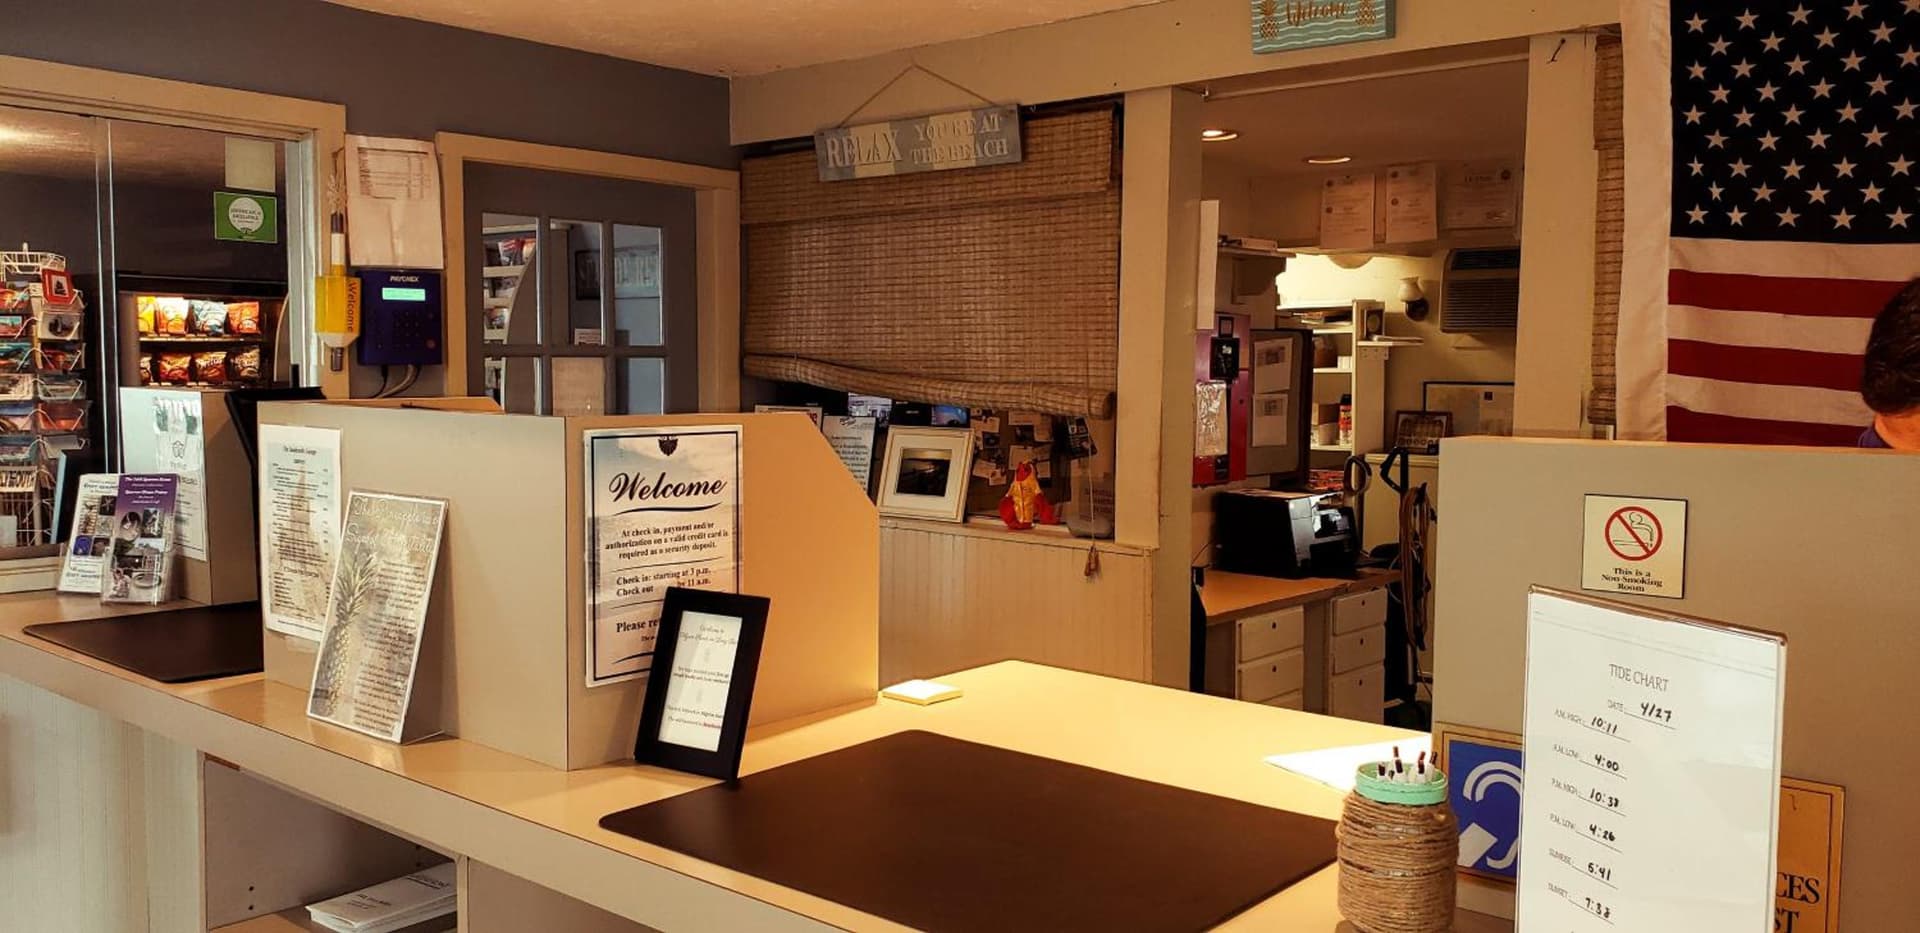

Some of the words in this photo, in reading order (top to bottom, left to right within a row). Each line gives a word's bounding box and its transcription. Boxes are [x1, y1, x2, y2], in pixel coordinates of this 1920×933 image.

[980, 112, 1002, 133] AT
[826, 131, 903, 168] RELAX
[910, 147, 945, 164] THE
[949, 139, 1009, 161] BEACH
[348, 282, 358, 333] Welcome
[608, 472, 728, 502] Welcome
[605, 538, 652, 550] authorization
[653, 538, 662, 546] on
[670, 535, 685, 543] valid
[687, 533, 706, 541] credit
[707, 530, 721, 539] card
[621, 529, 630, 538] At
[632, 527, 651, 536] check
[663, 524, 692, 536] payment
[619, 549, 648, 560] required
[664, 543, 690, 553] security
[692, 541, 718, 551] deposit.
[616, 576, 640, 586] Check
[653, 571, 680, 580] starting
[696, 568, 711, 576] p.m.
[1601, 574, 1663, 587] Non-Smoking
[1614, 568, 1633, 576] This
[616, 587, 640, 597] Check
[642, 585, 654, 593] out
[1618, 583, 1645, 592] Room
[616, 620, 646, 632] Please
[648, 619, 659, 628] re
[1609, 663, 1632, 682] TIDE
[1633, 671, 1669, 692] CHART
[1641, 702, 1673, 722] 4/27
[1591, 716, 1618, 734] 10:11
[1594, 753, 1619, 771] 4:00
[1589, 824, 1616, 841] 4:26
